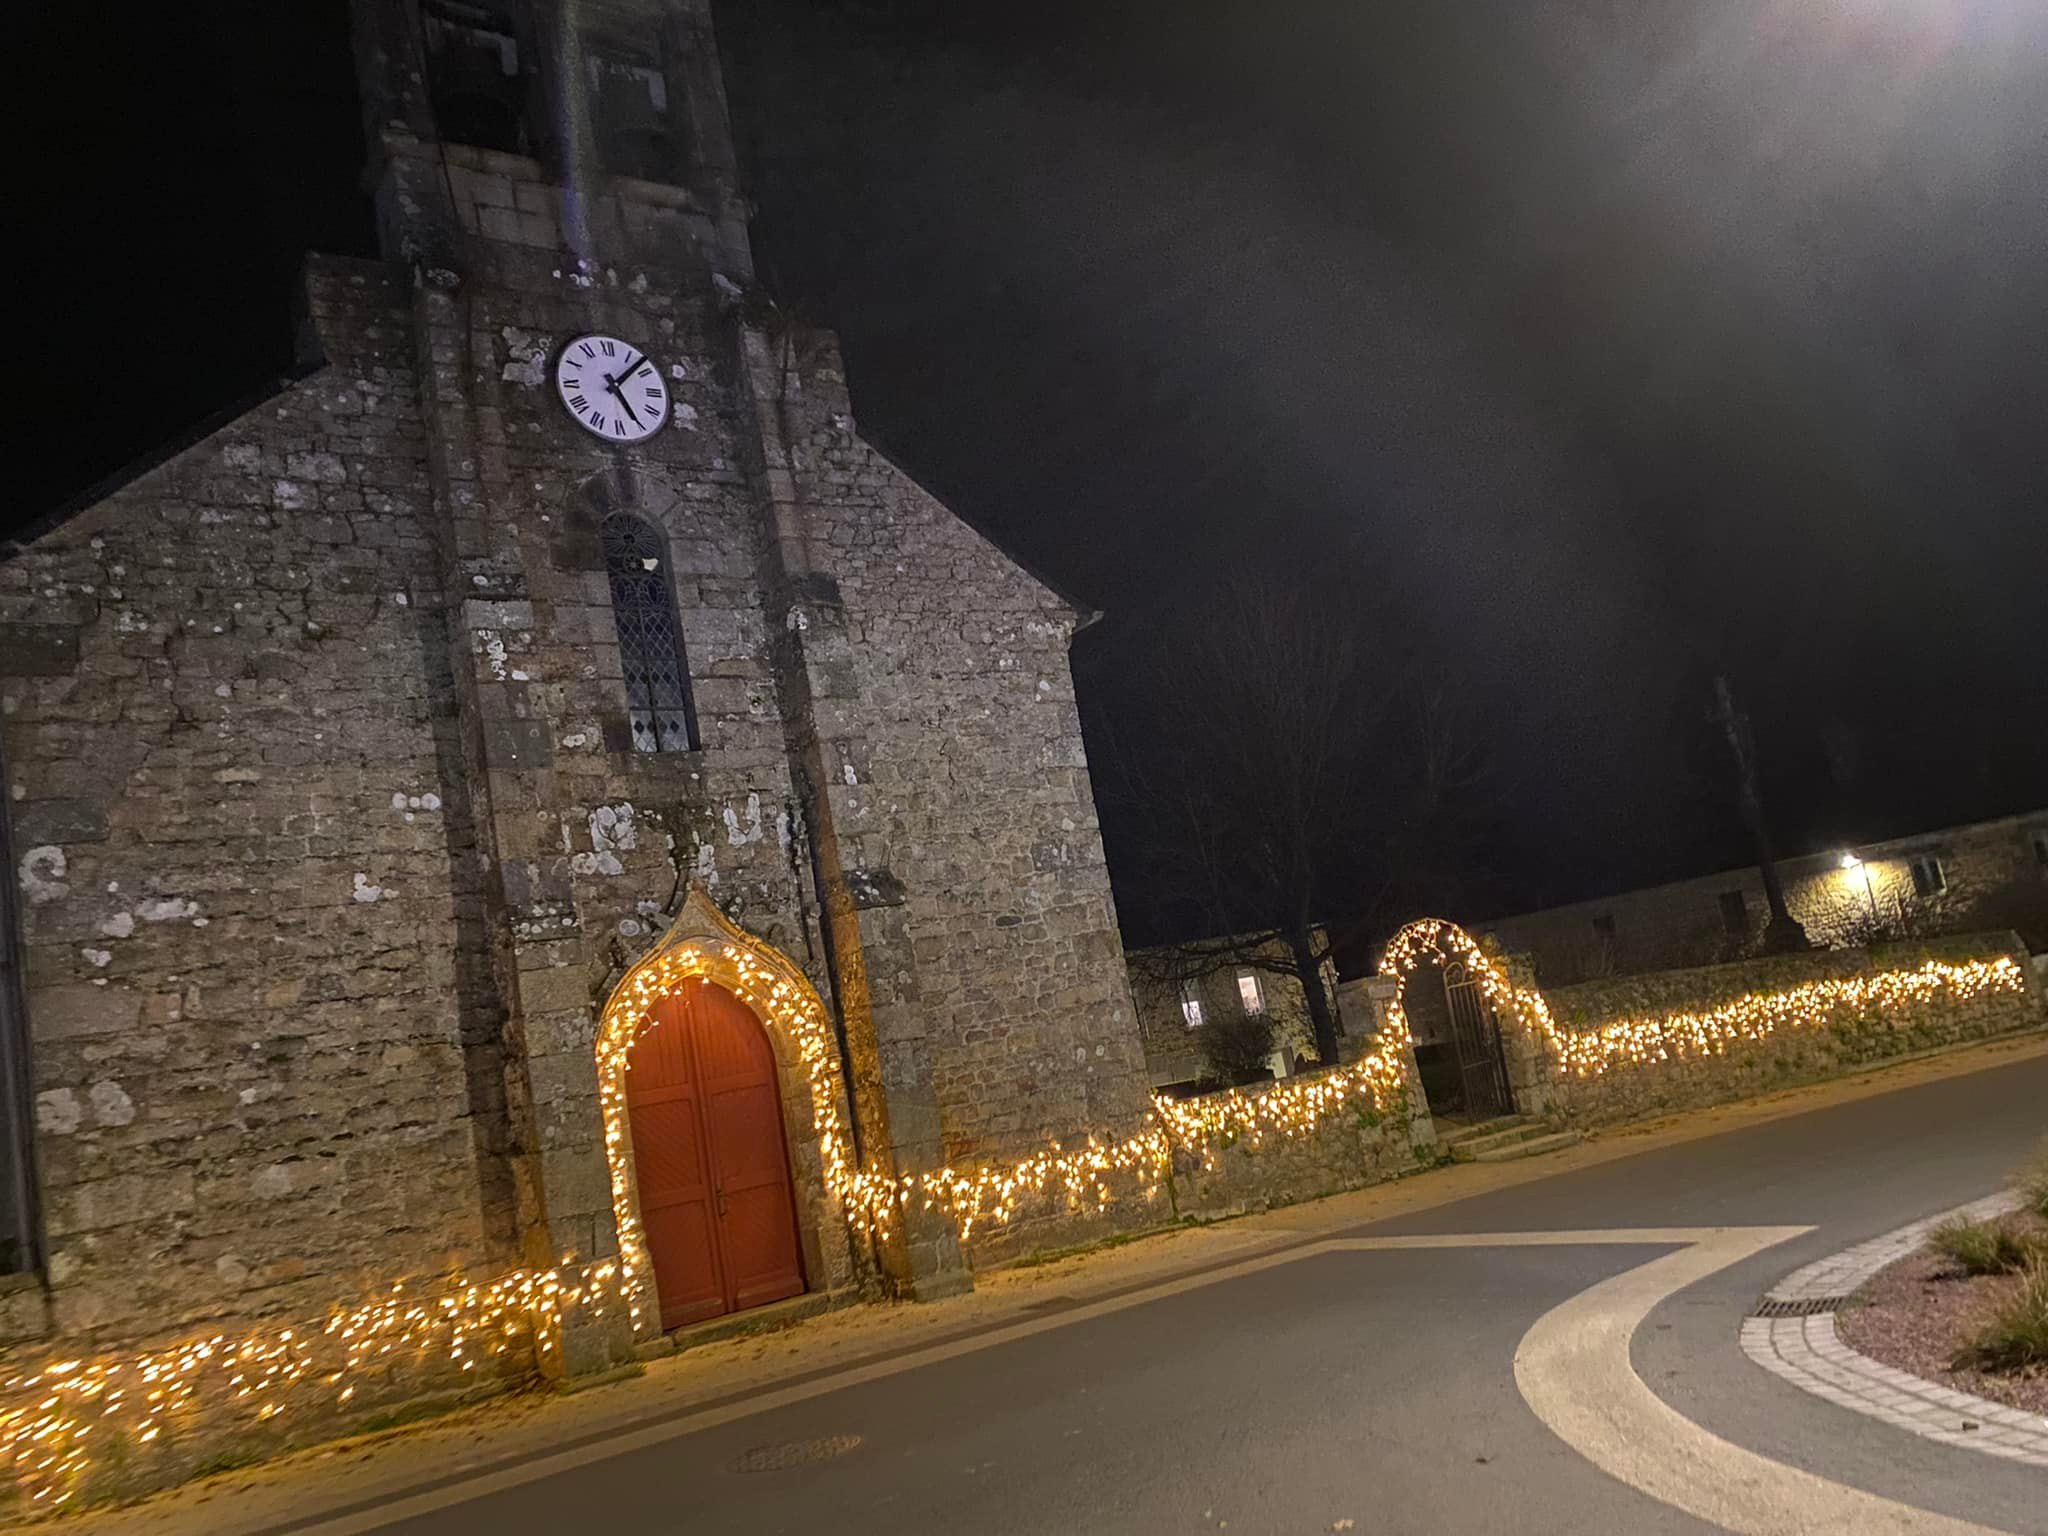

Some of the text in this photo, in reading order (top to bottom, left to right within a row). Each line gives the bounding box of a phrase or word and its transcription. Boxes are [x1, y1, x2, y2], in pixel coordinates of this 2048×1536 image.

[578, 342, 596, 360] XI
[600, 340, 615, 357] XII
[565, 357, 582, 371] X
[624, 350, 632, 364] I
[637, 367, 653, 378] II
[562, 377, 580, 389] IX
[645, 387, 662, 399] III
[569, 394, 590, 415] VIII
[643, 404, 661, 420] IV
[589, 411, 605, 431] VII
[614, 419, 626, 436] VI
